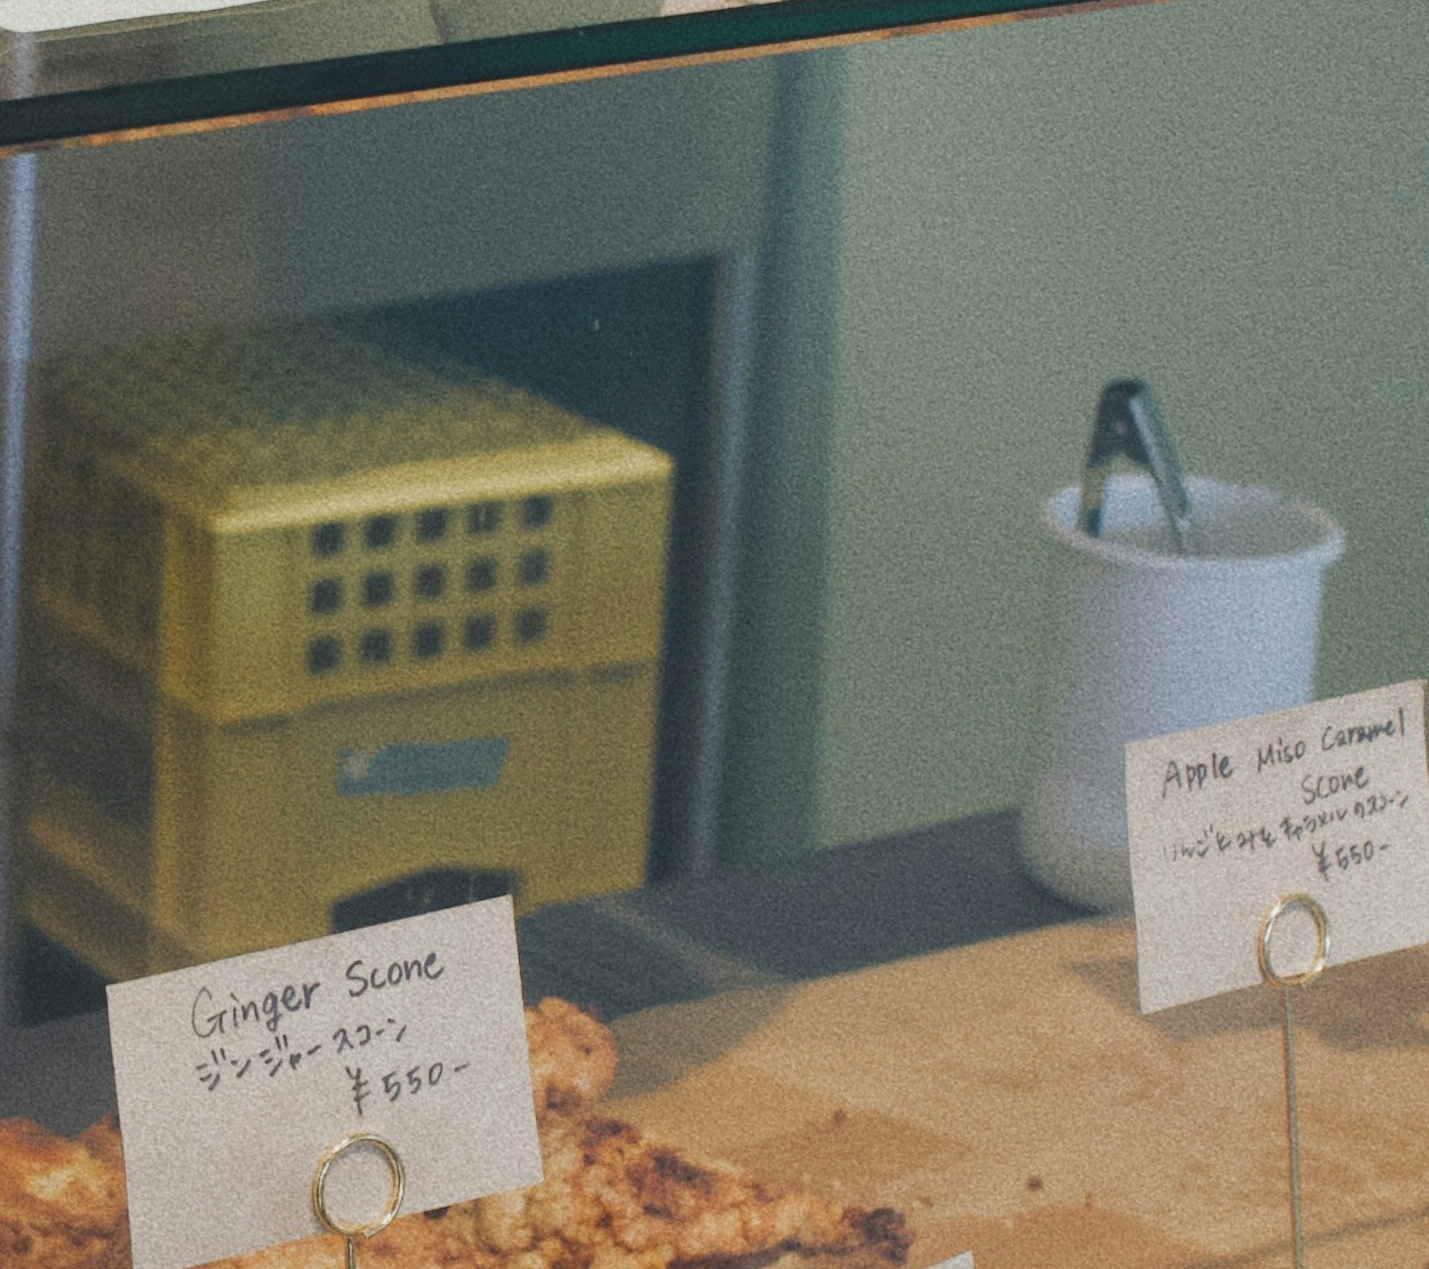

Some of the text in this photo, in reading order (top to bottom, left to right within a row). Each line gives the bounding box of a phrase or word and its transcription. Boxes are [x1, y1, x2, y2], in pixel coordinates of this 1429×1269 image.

[1161, 706, 1406, 799] Apple Miso Caramel
[1300, 764, 1370, 806] Scone
[190, 949, 445, 1039] Ginger Scone
[195, 1017, 408, 1092] ジンジャースコーン
